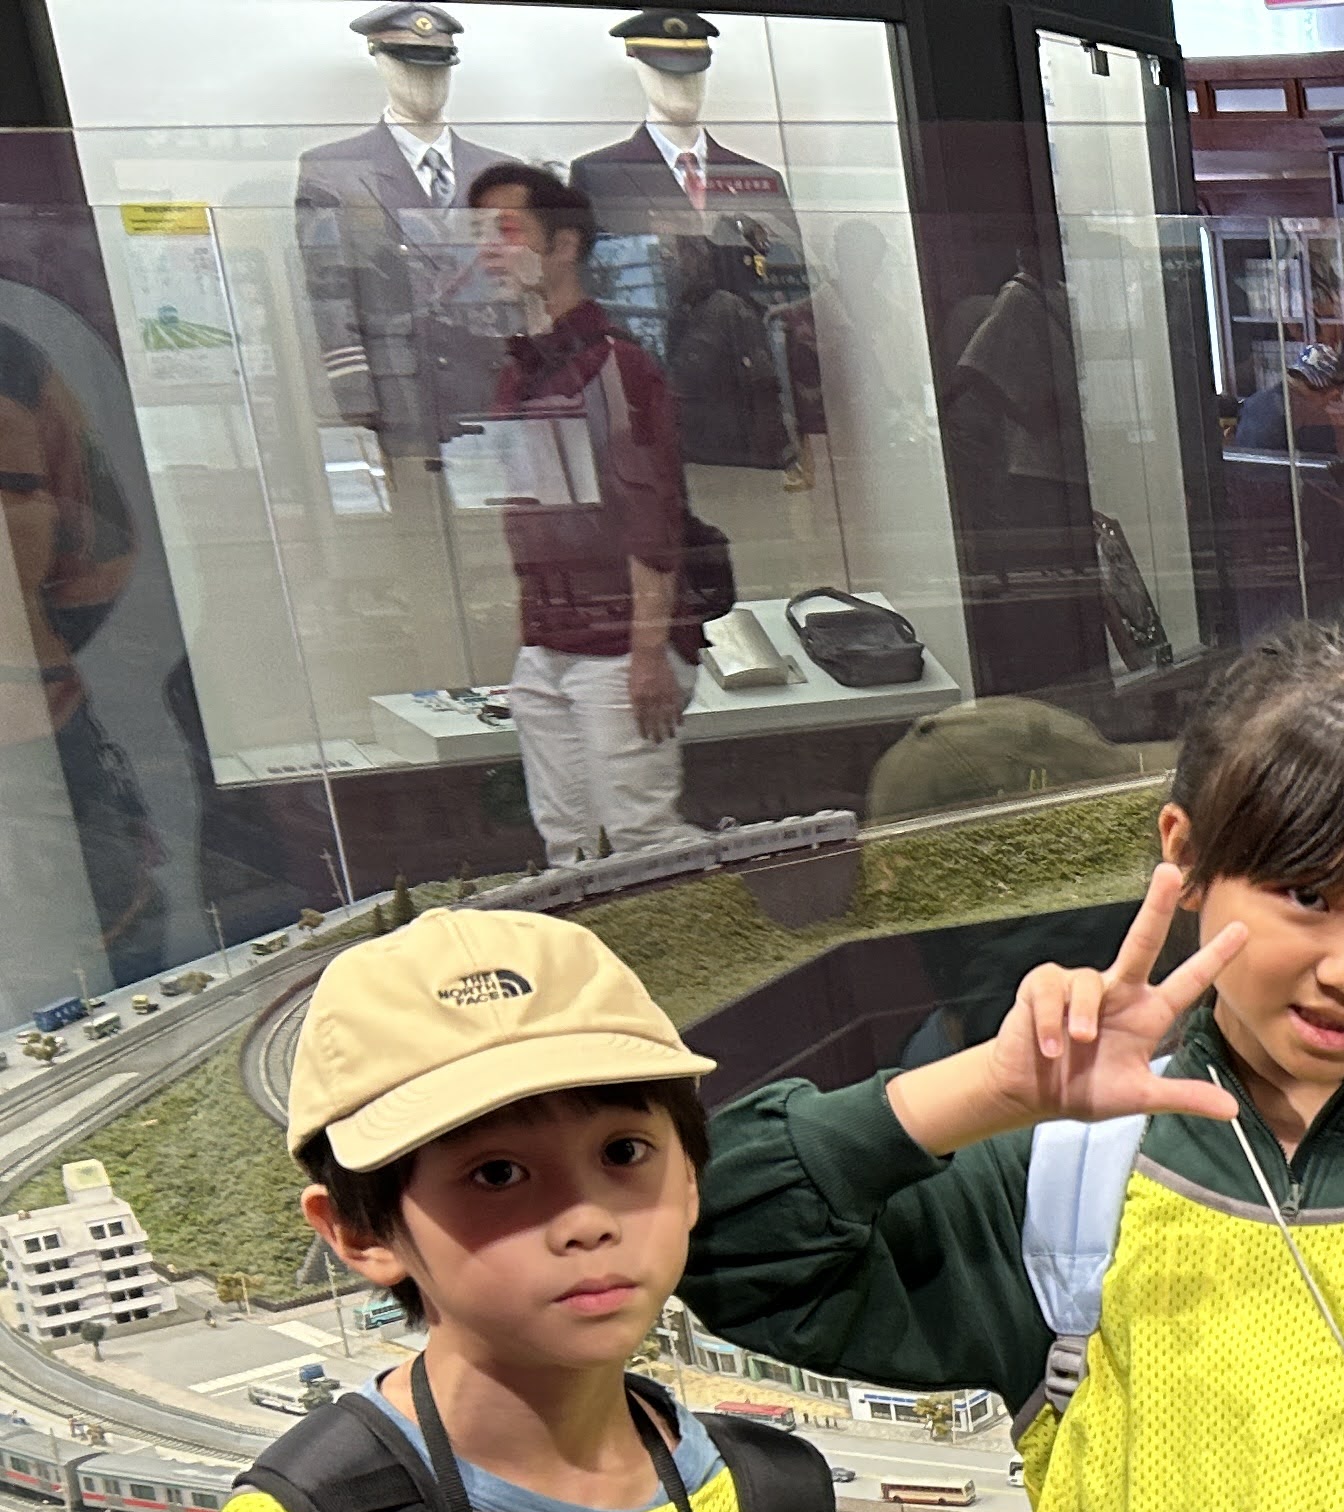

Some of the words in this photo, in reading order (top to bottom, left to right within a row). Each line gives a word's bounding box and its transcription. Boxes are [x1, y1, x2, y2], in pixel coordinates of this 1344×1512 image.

[461, 972, 493, 987] THE
[438, 982, 498, 999] NORTH
[456, 991, 500, 1006] FACE
